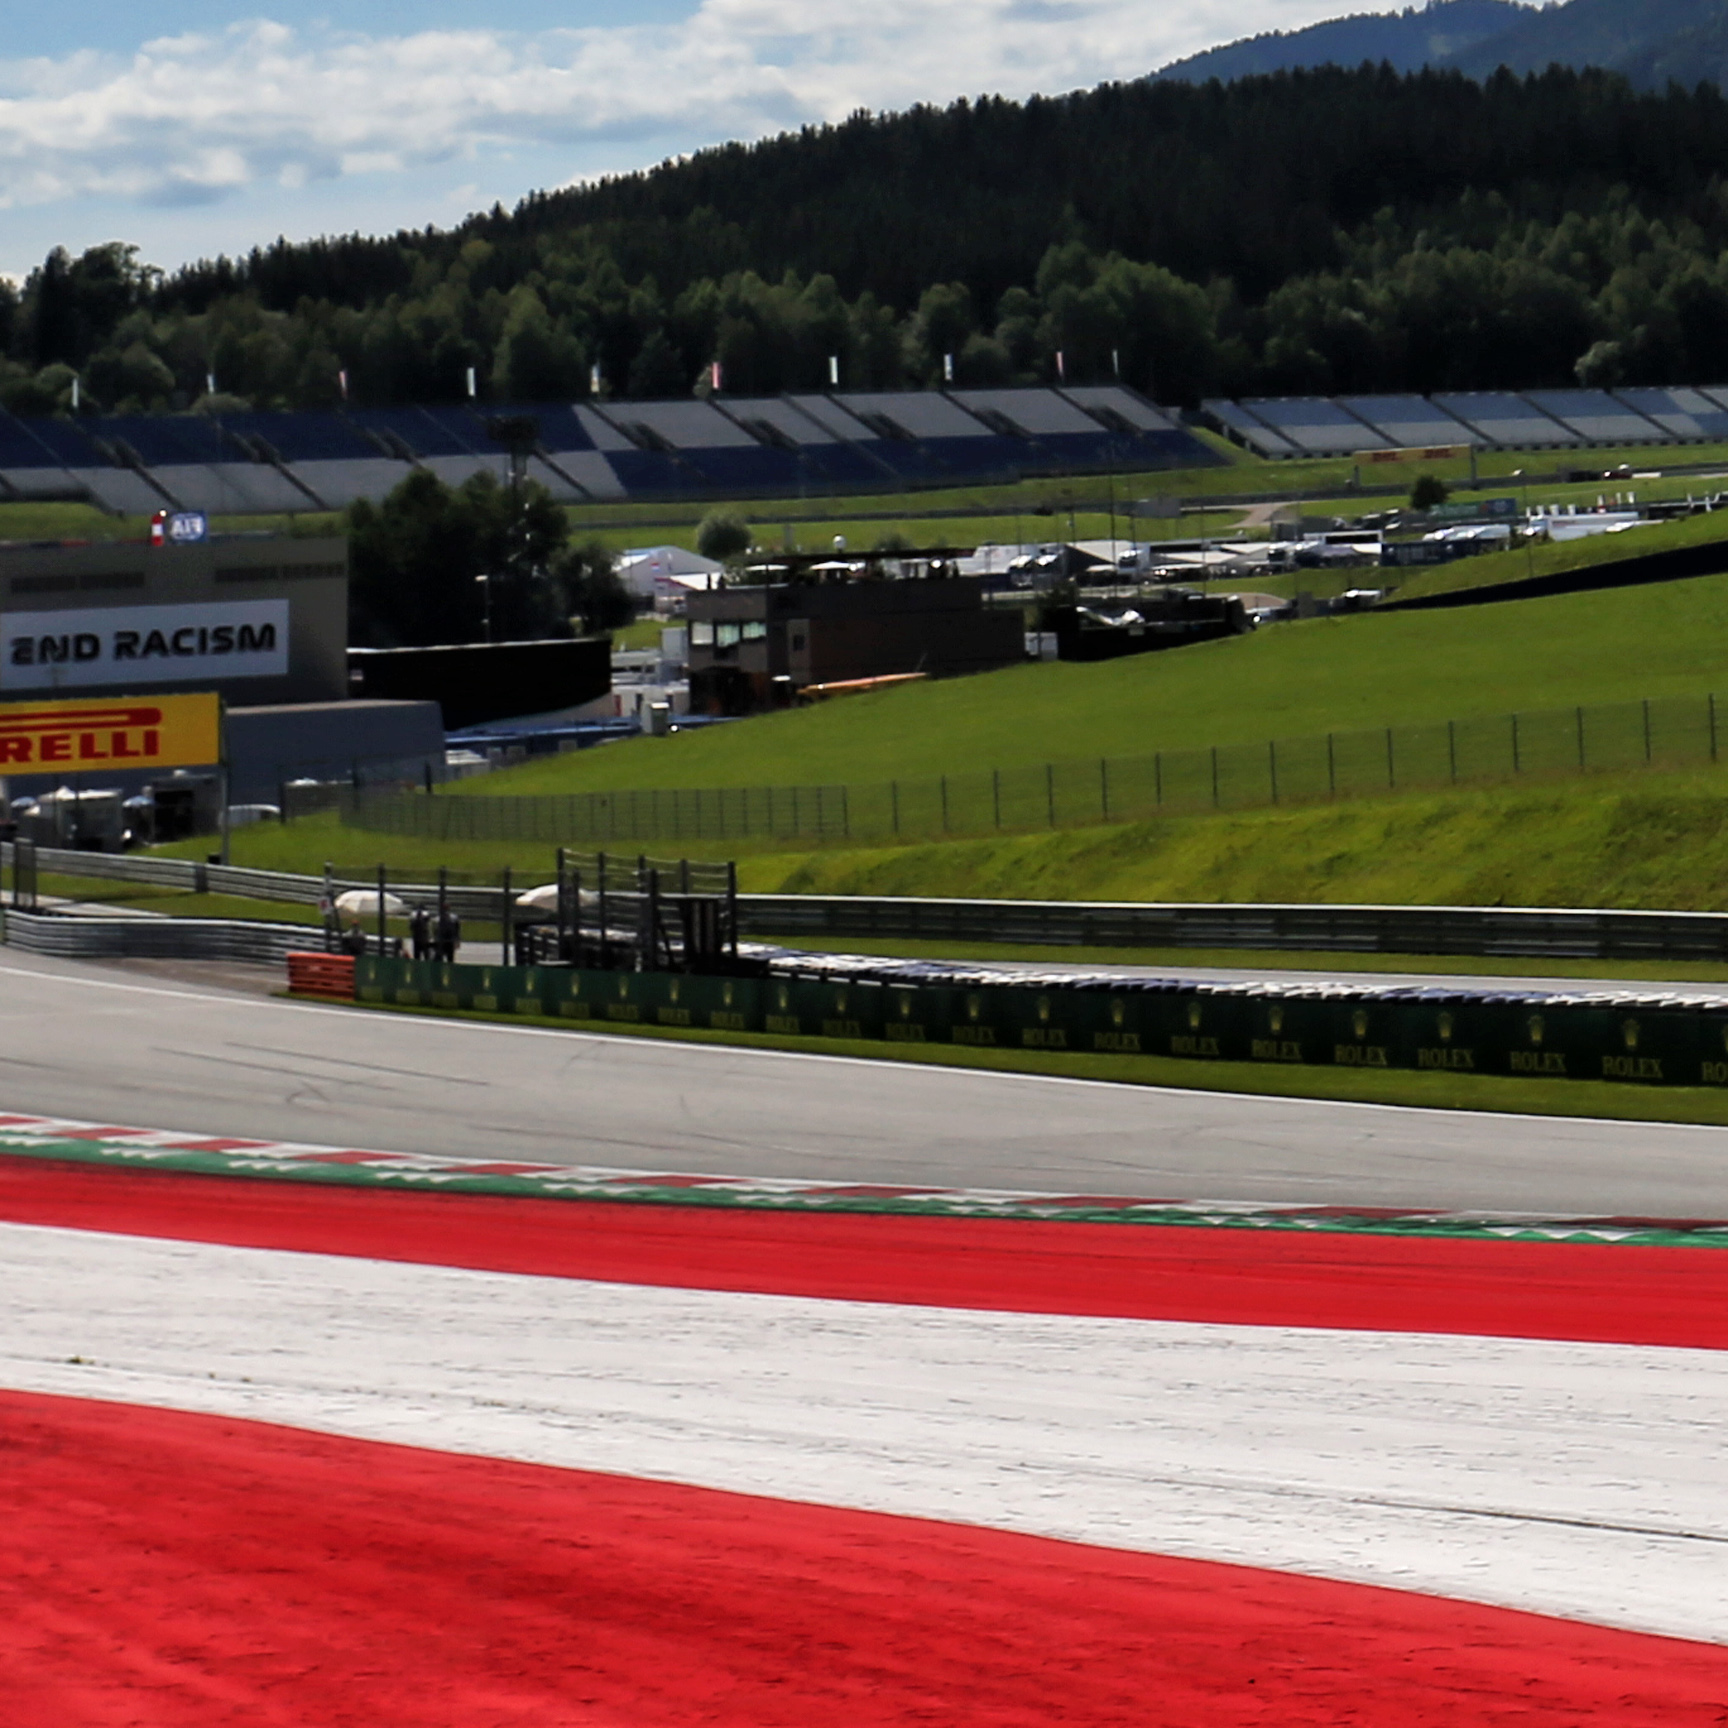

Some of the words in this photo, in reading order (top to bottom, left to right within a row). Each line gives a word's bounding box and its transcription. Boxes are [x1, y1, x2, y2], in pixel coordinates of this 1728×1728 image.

[10, 632, 101, 666] END
[113, 622, 277, 662] RACISM
[1418, 1048, 1474, 1069] ROLEX
[1510, 1052, 1566, 1073] ROLEX
[1602, 1056, 1663, 1079] ROLEX
